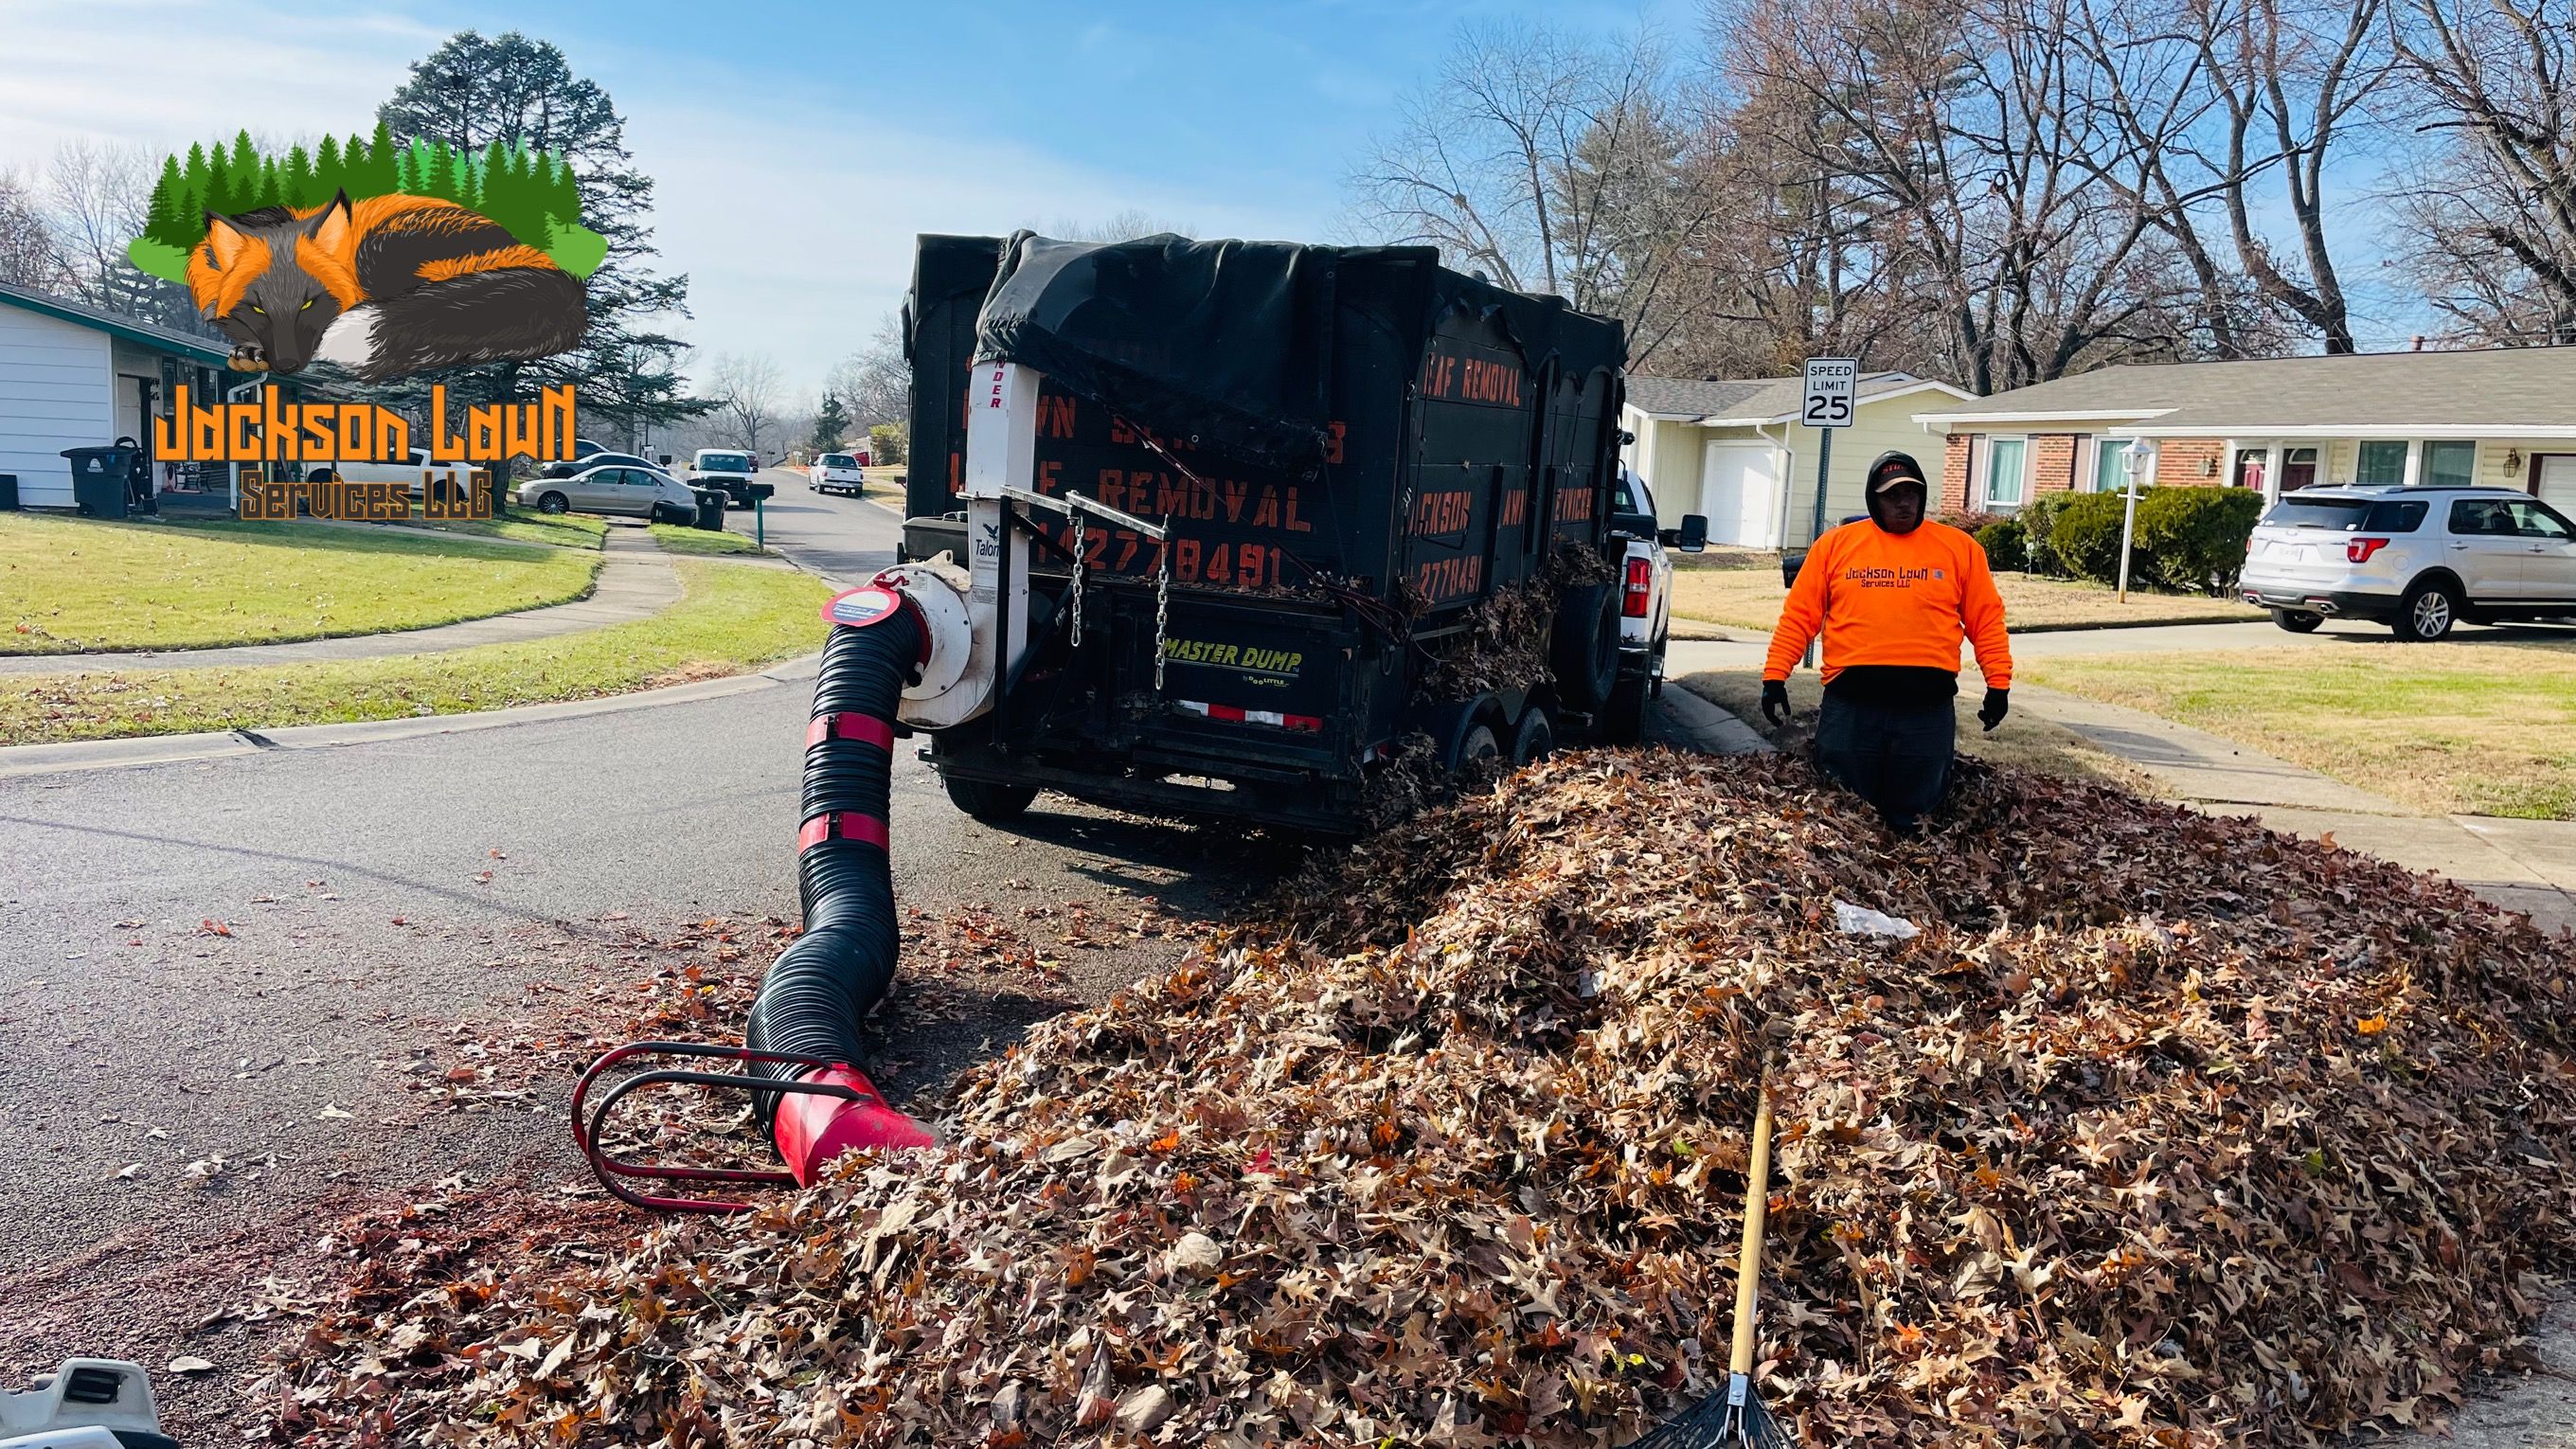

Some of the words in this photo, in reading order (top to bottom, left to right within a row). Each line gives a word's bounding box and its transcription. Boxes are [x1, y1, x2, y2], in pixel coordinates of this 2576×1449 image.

[1810, 366, 1852, 376] SPEED
[1462, 358, 1519, 407] REMOVAL
[1813, 381, 1847, 391] LIMIT
[1807, 395, 1849, 420] 25
[1098, 469, 1312, 531] REMOVAL
[975, 538, 999, 557] Talon
[1861, 579, 1894, 588] Services
[1164, 637, 1238, 665] MASTER
[1241, 647, 1302, 672] DUMP
